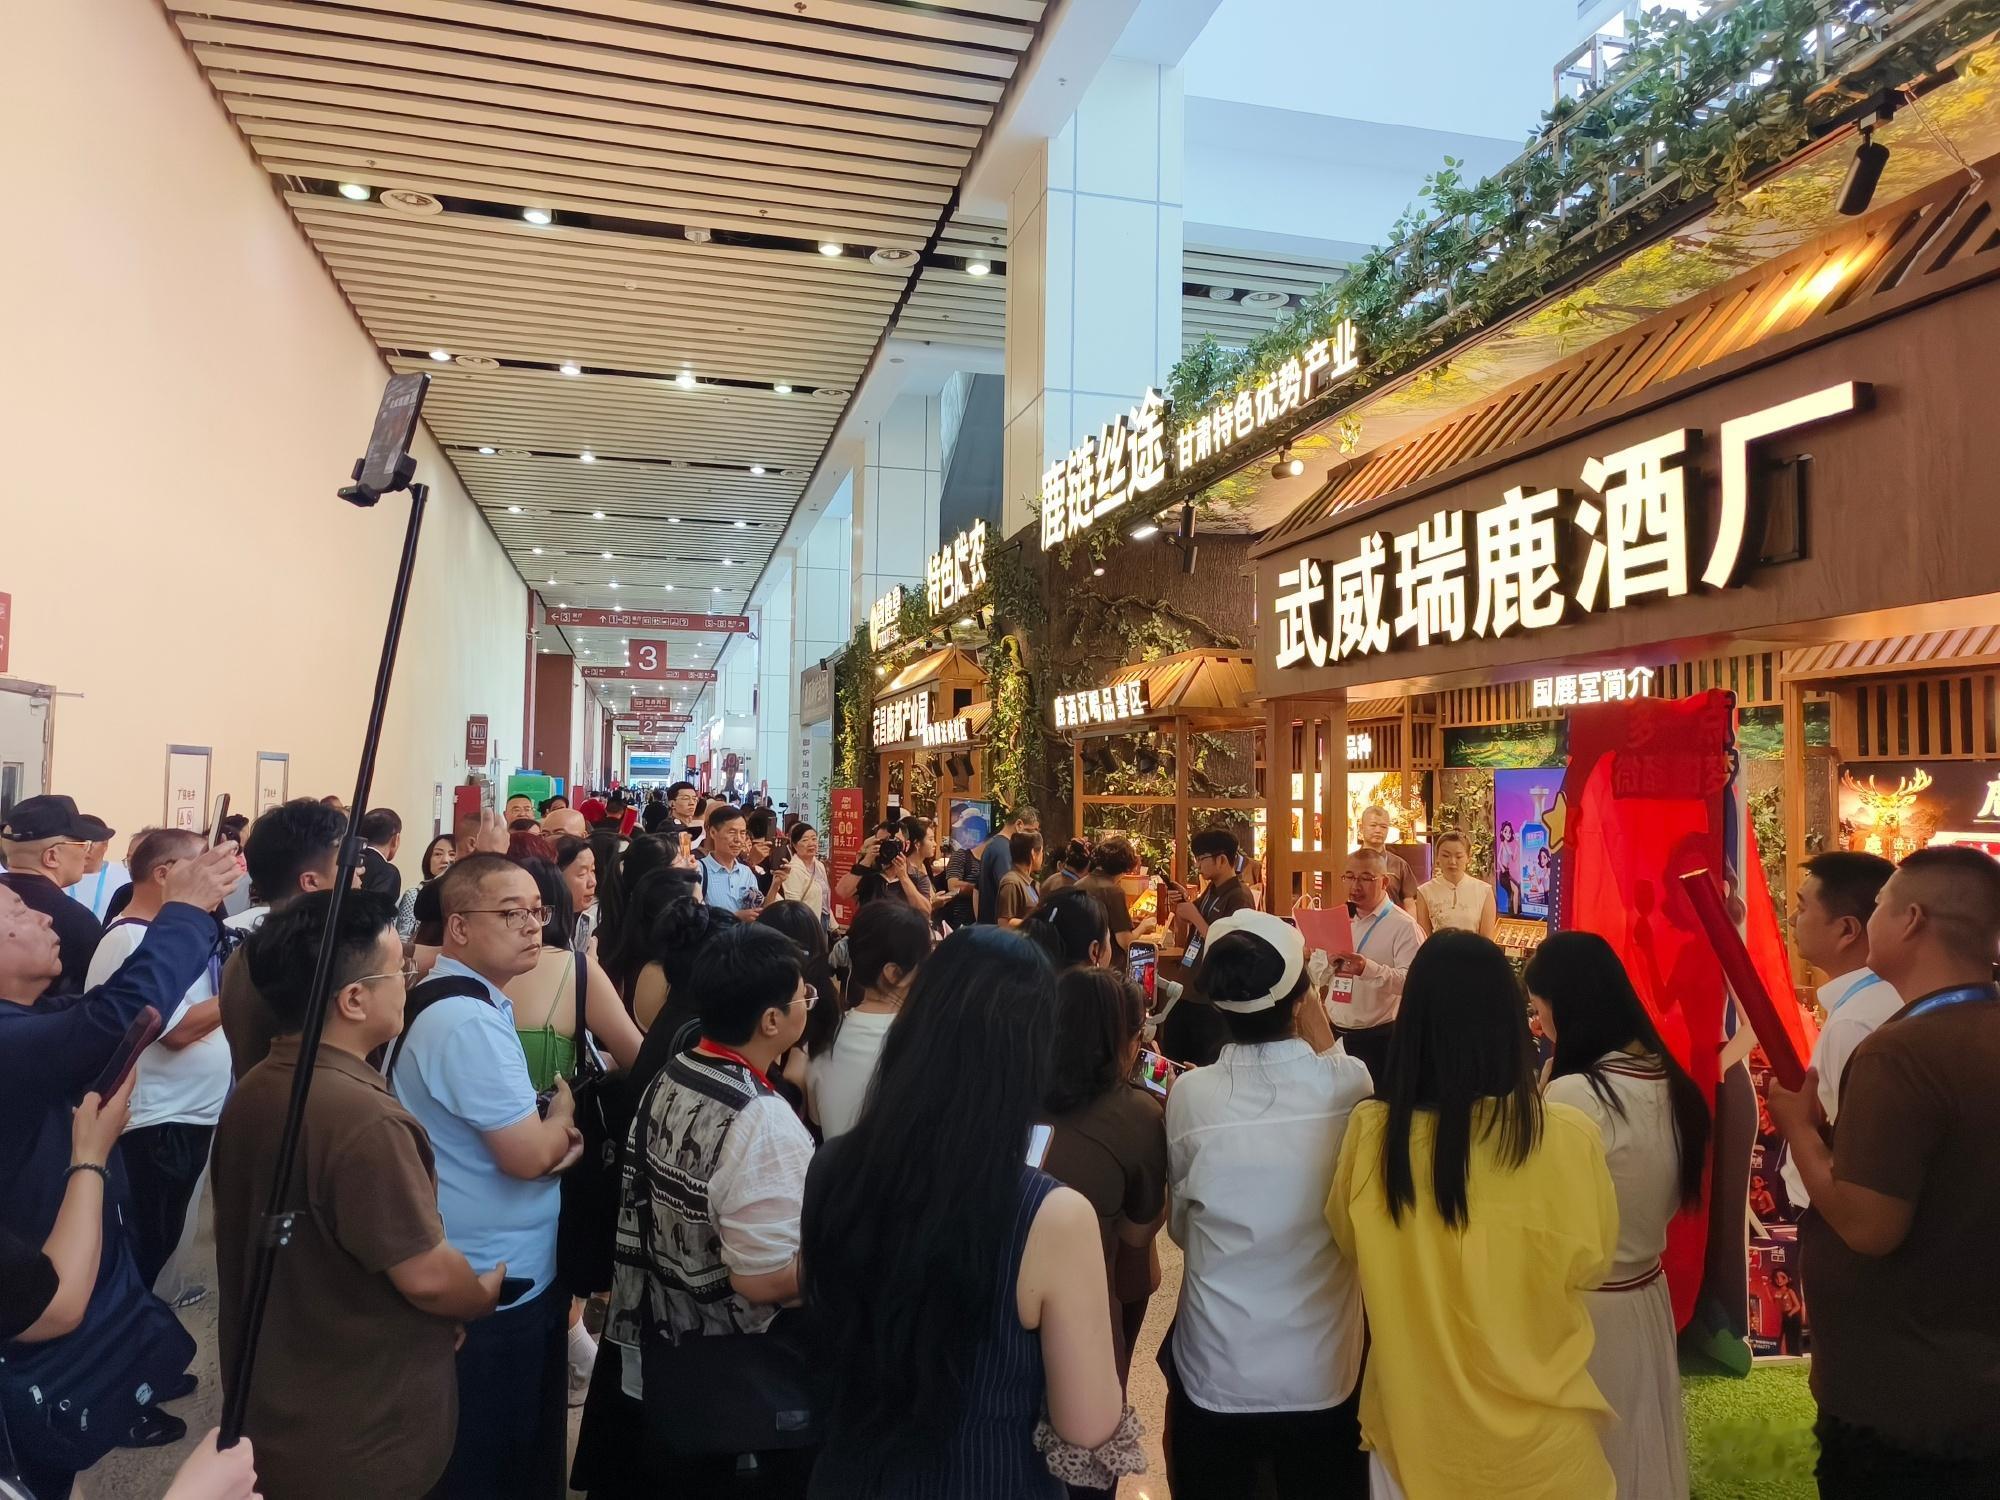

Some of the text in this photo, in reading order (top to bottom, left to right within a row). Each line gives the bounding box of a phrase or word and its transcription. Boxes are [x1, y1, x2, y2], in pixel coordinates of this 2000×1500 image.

[1176, 319, 1358, 472] 甘肃特色优势产业
[1274, 380, 1855, 670] 武威瑞鹿酒厂
[638, 645, 658, 671] 3
[643, 720, 653, 733] 2
